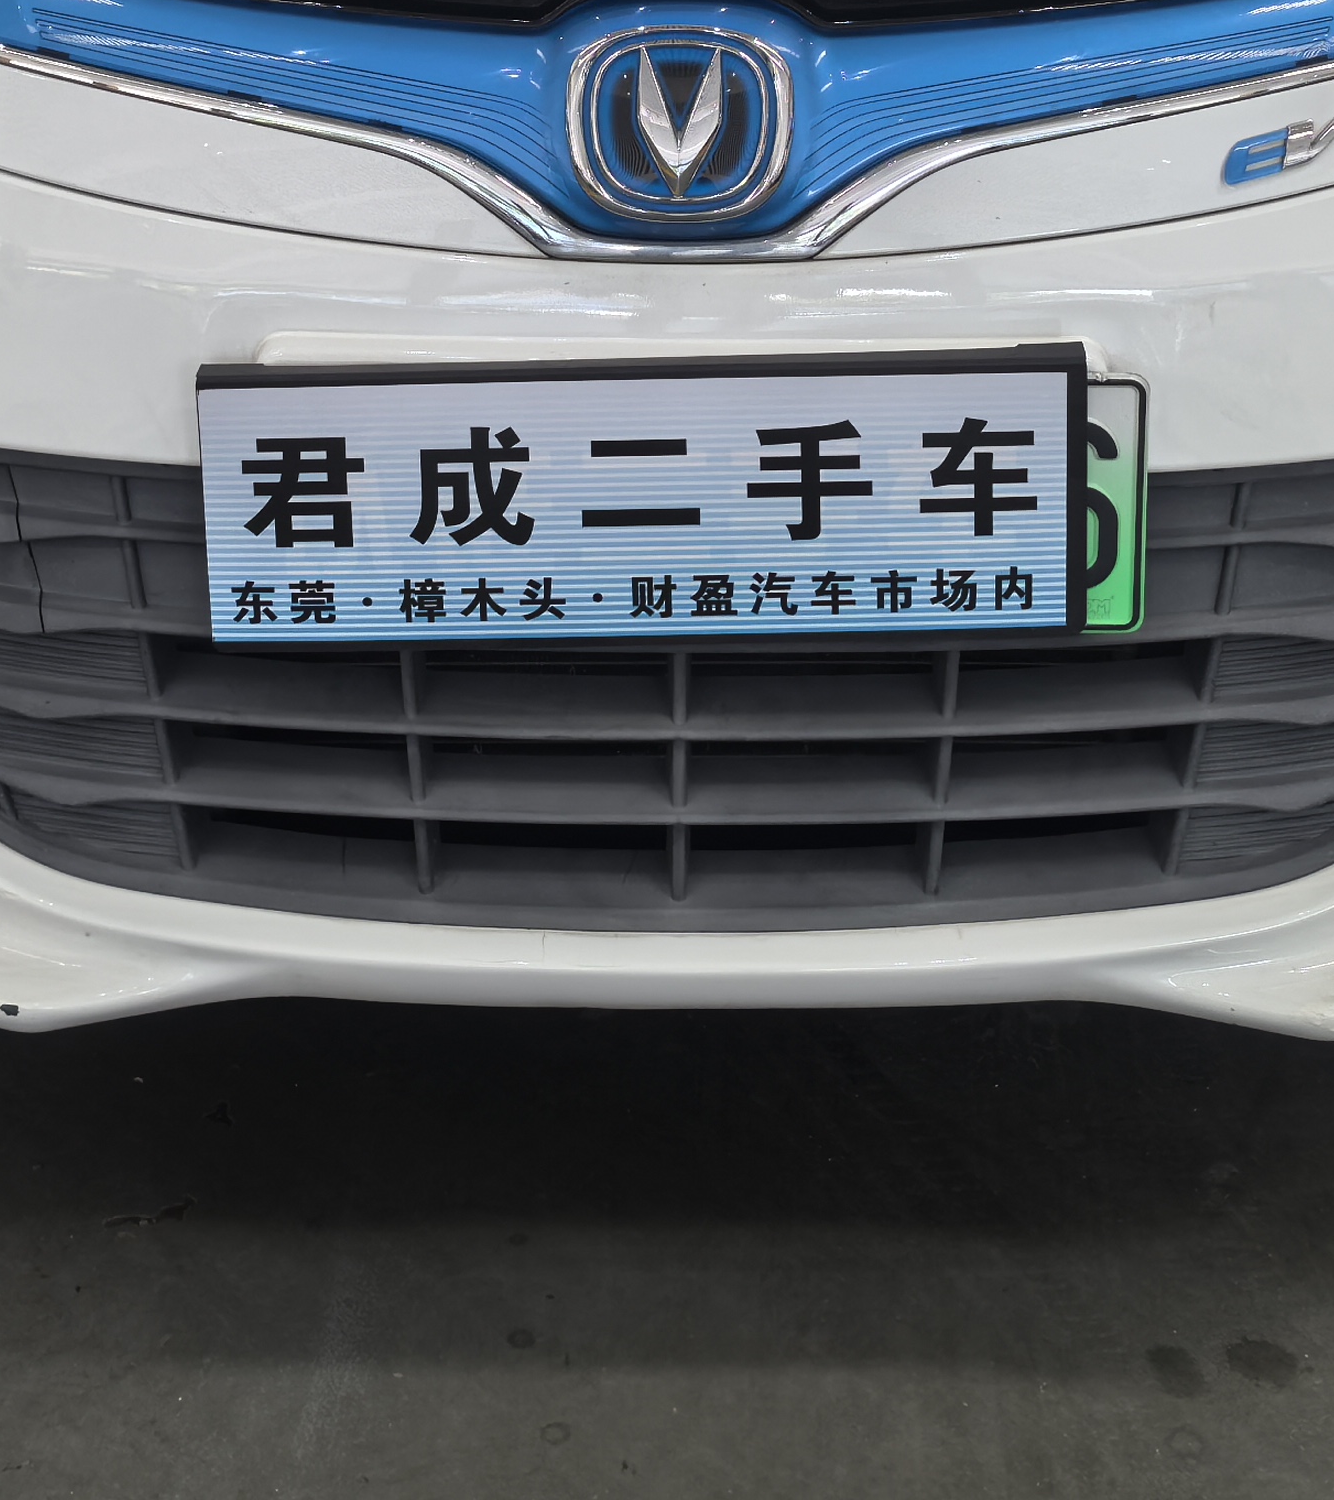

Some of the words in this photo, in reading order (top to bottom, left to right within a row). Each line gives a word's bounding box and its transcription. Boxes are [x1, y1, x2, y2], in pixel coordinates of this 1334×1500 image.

[240, 417, 1039, 548] 君成二手车
[231, 566, 1037, 625] 东莞·樟木头·财盈汽车市场内
